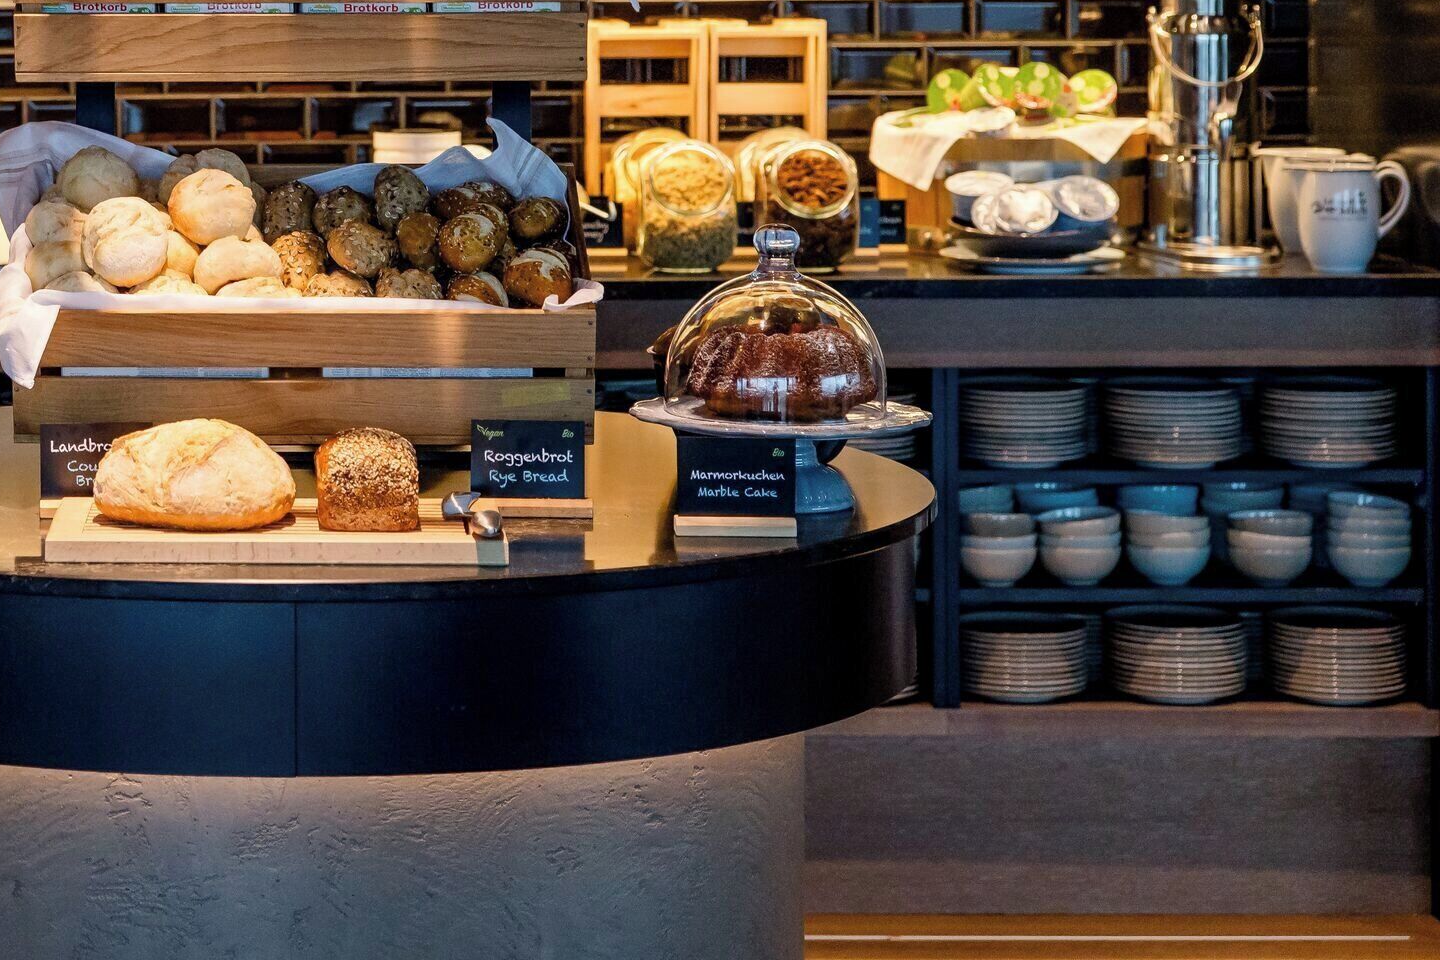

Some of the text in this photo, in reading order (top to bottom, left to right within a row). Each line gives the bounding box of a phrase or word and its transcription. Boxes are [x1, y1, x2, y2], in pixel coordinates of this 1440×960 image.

[73, 2, 127, 12] Brotkorb
[343, 3, 399, 12] Brotkorb
[561, 428, 575, 438] Bio
[50, 437, 113, 452] Landbro
[484, 447, 573, 467] Roggenbrot
[771, 447, 785, 457] Bio
[489, 468, 570, 488] Rye Bread
[690, 469, 786, 481] Marmorkuchen
[697, 484, 779, 498] Marble Cake
